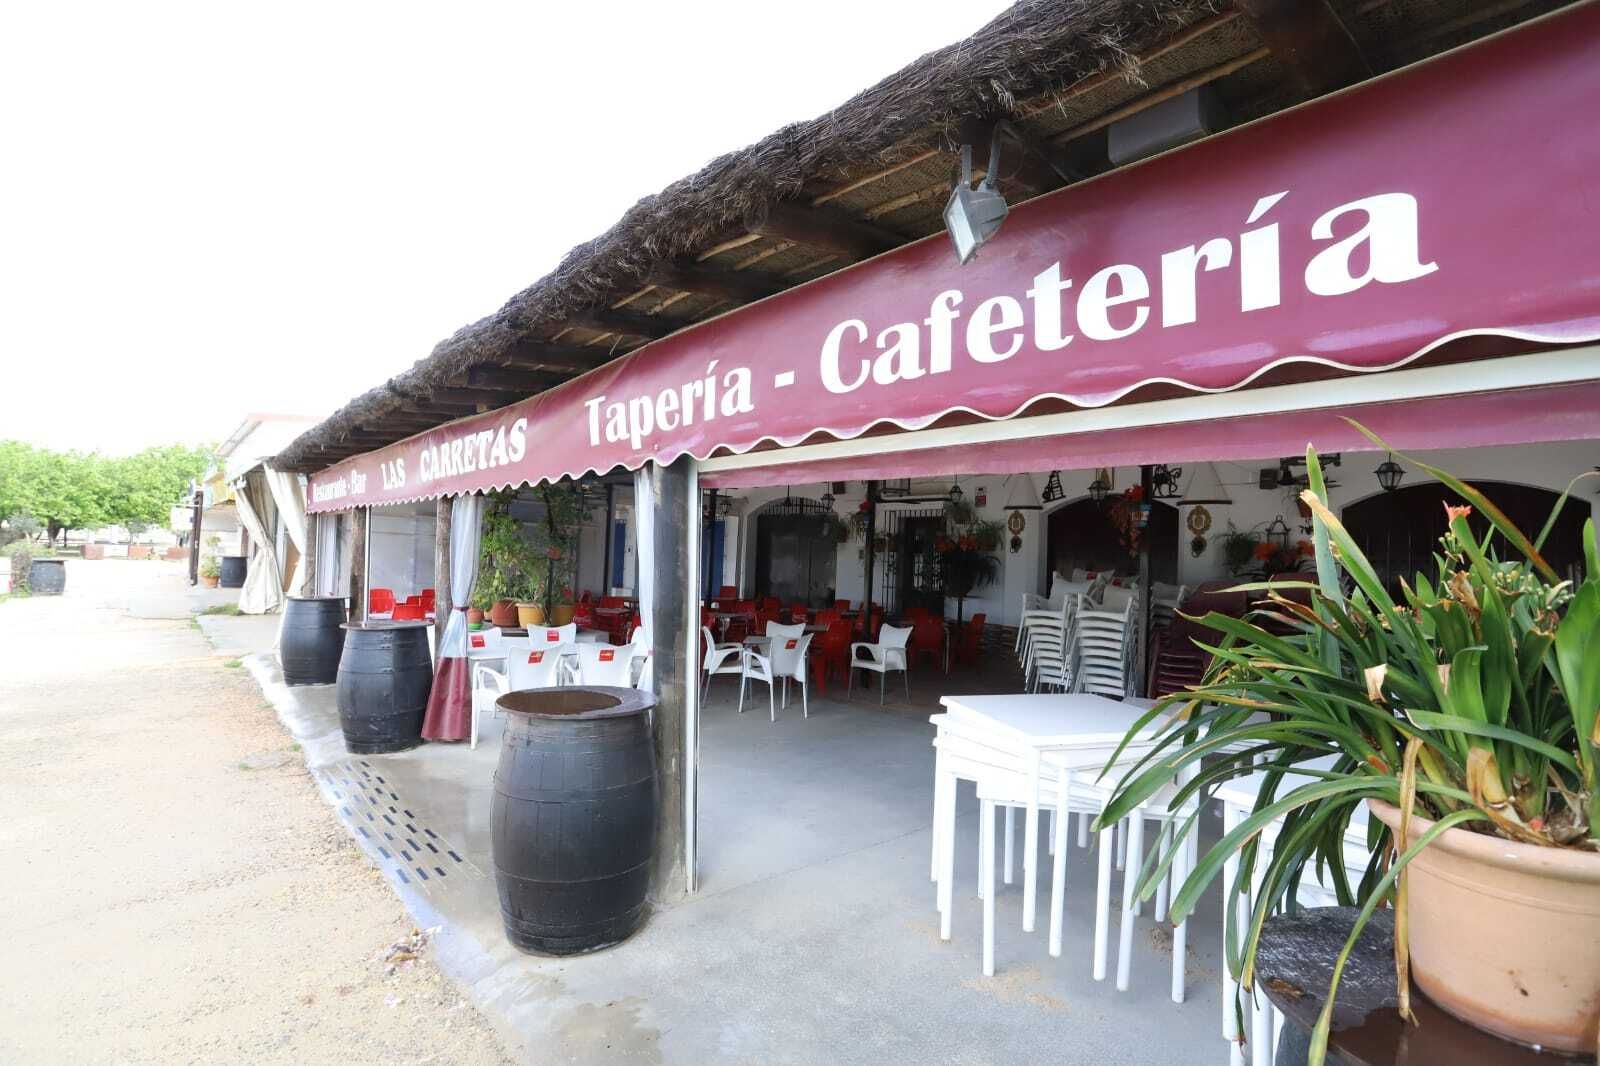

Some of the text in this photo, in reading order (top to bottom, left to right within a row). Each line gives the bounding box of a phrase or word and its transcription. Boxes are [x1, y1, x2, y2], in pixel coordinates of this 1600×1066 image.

[351, 469, 367, 495] Bar
[380, 457, 406, 490] LAS
[419, 417, 528, 483] CARRETAS
[584, 359, 755, 450] Tapería
[774, 370, 795, 389] -
[818, 189, 1439, 394] Cafetería
